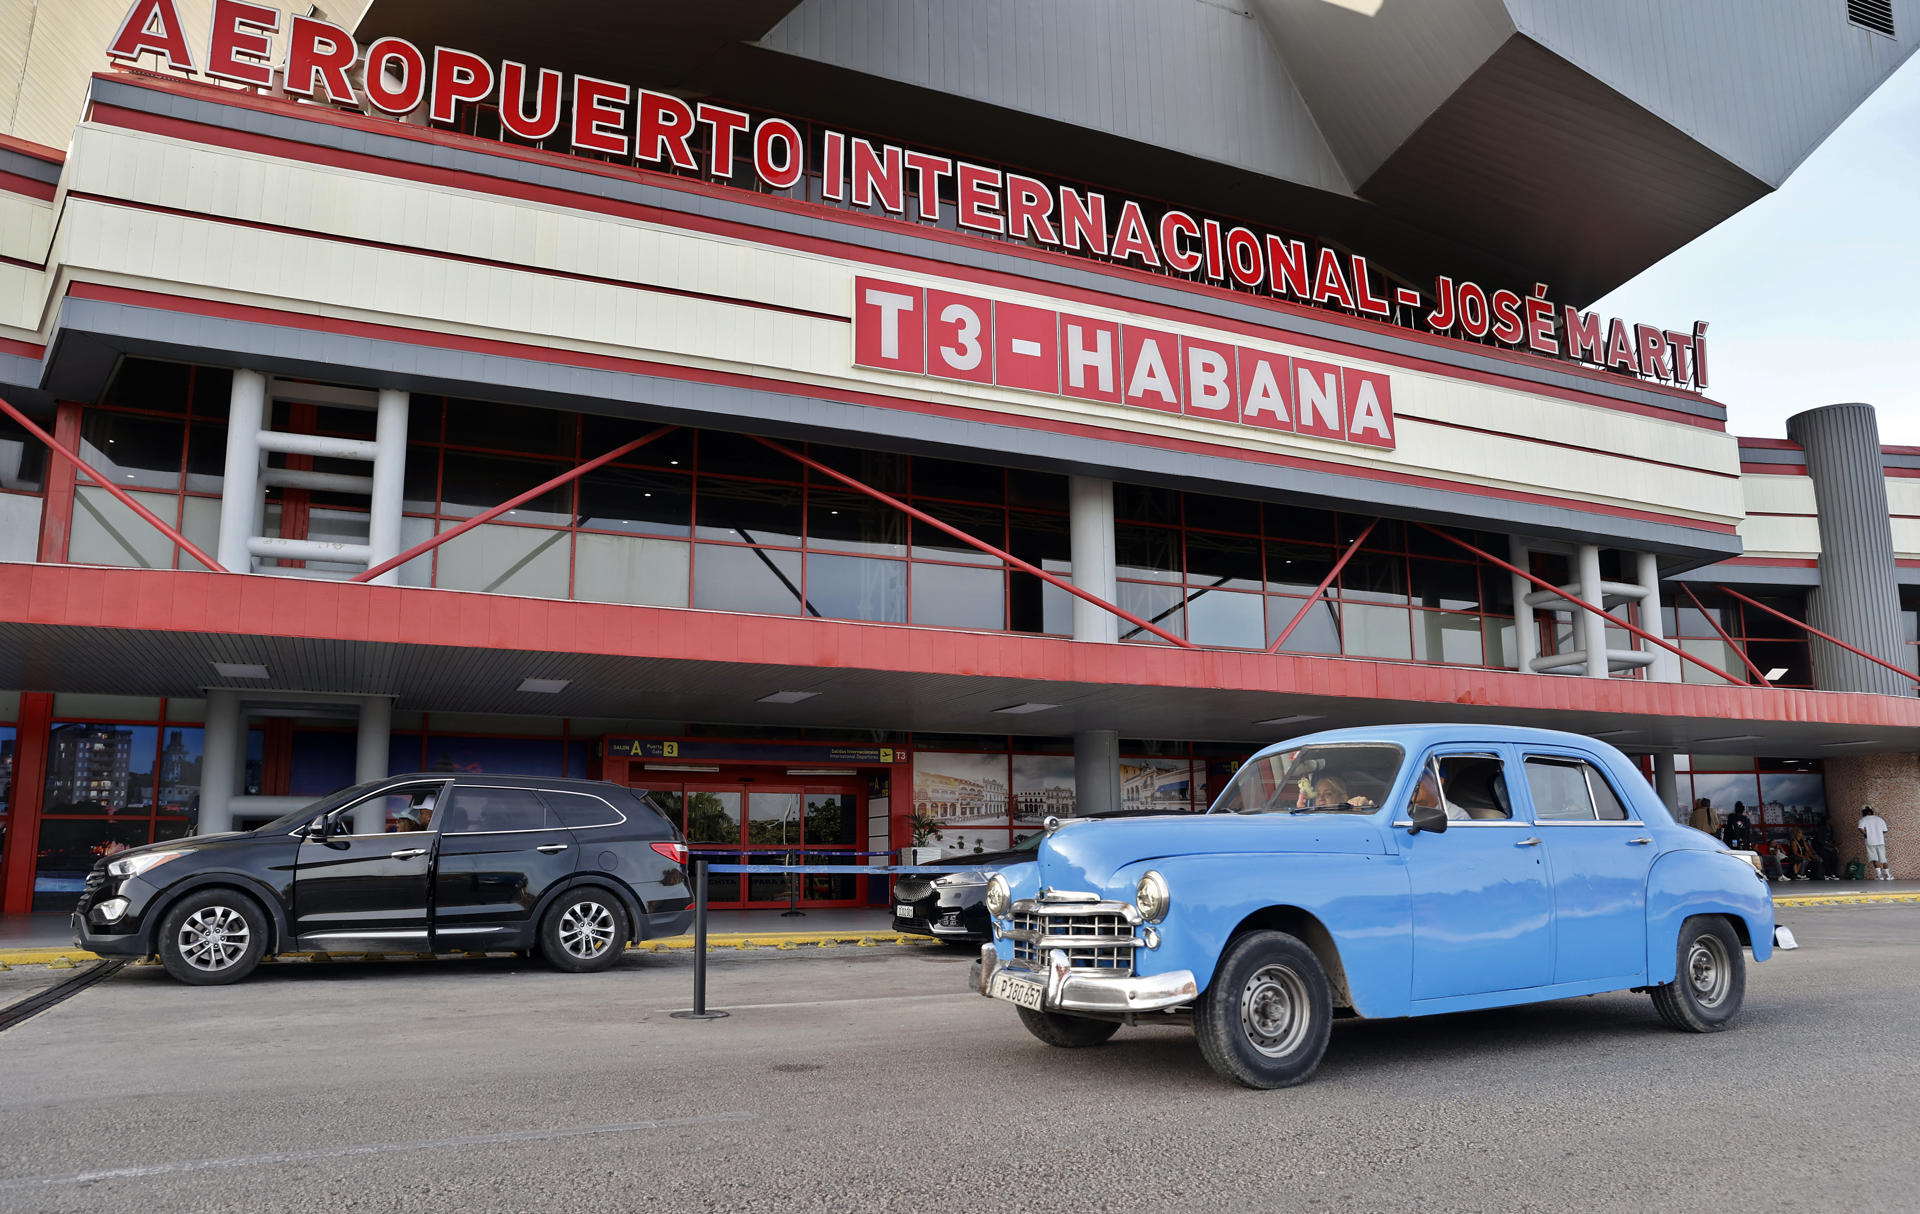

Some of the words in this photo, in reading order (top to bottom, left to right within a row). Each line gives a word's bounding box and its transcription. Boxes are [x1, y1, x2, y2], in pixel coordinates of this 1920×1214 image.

[105, 0, 803, 190] AEROPUERTO
[822, 130, 1390, 316] INTERNACIONAL
[1427, 282, 1560, 355] JOSÉ
[1562, 320, 1710, 389] MARTÍ
[630, 740, 642, 756] A
[667, 744, 674, 755] 3
[896, 751, 906, 760] T3
